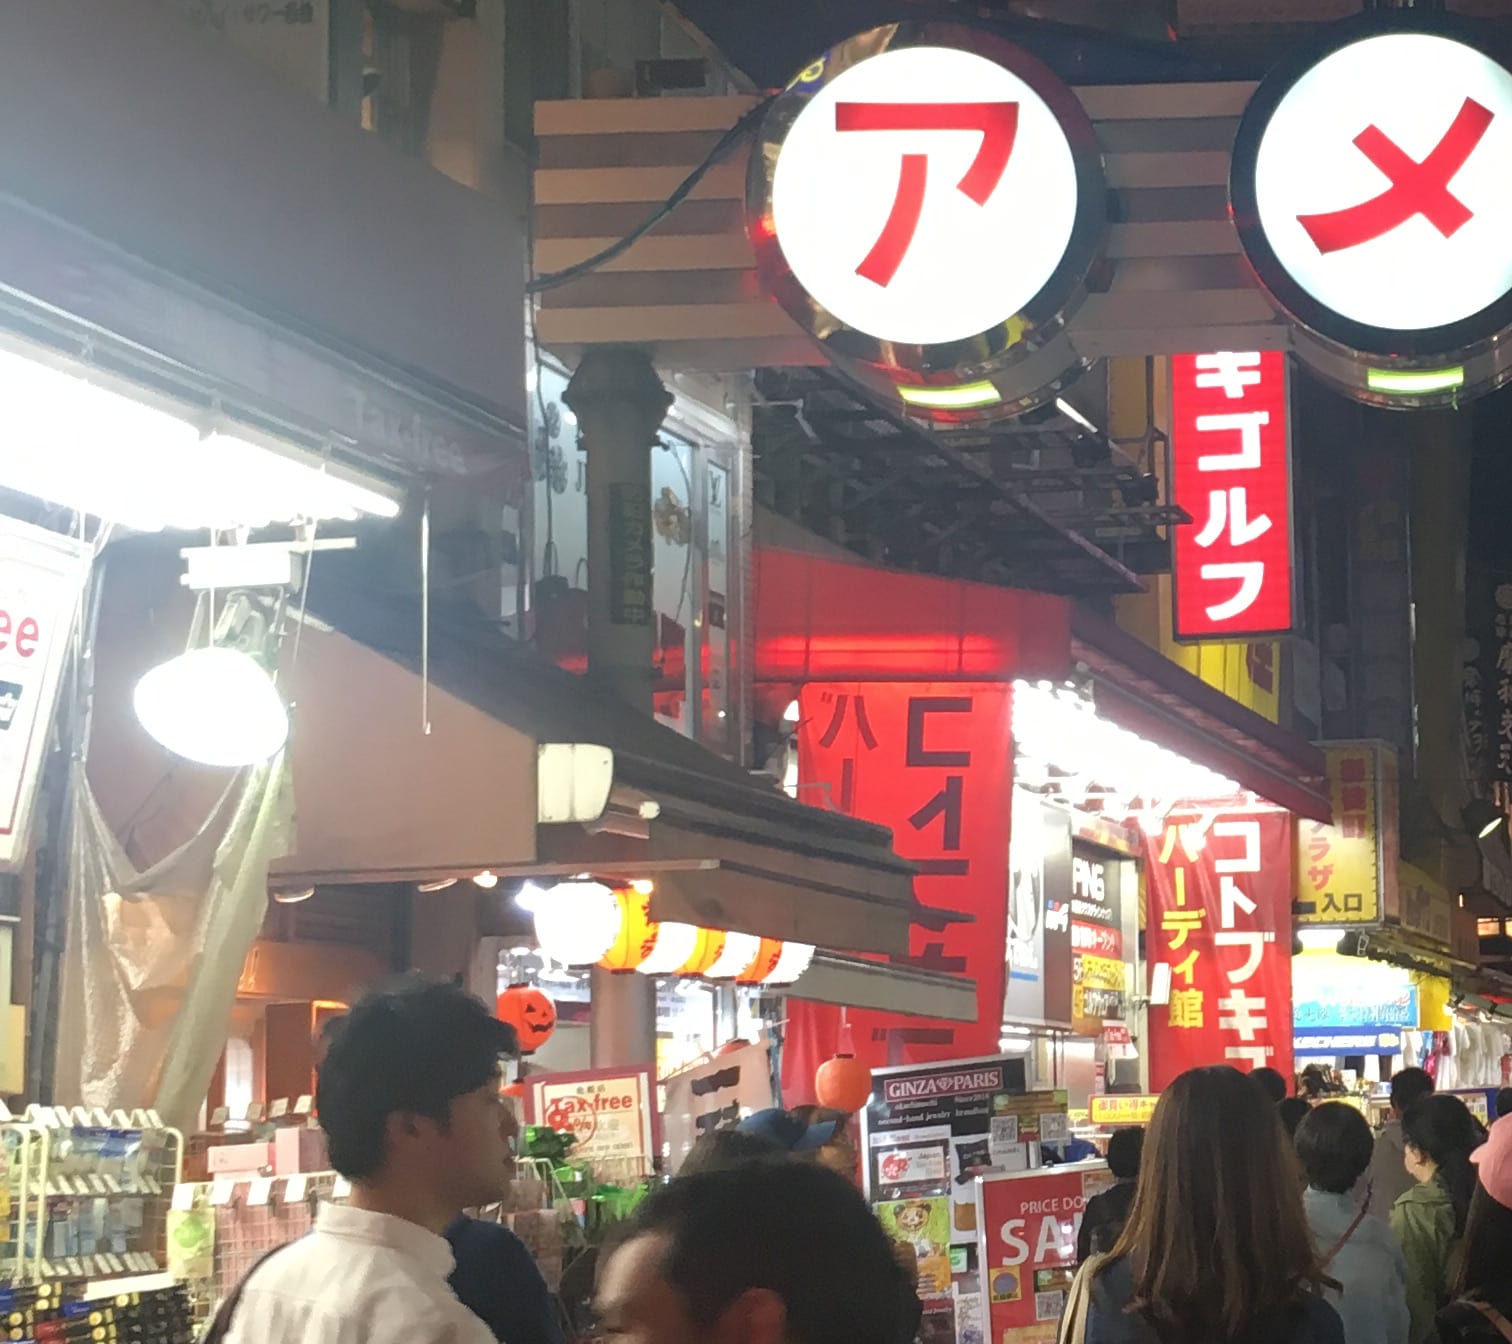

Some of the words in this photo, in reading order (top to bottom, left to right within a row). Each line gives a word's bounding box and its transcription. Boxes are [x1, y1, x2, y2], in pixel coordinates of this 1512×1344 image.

[1073, 857, 1105, 902] PING
[1321, 893, 1363, 913] 入口
[889, 1080, 937, 1098] GINZA
[954, 1071, 999, 1090] PARIS
[1020, 1199, 1059, 1215] PRICE
